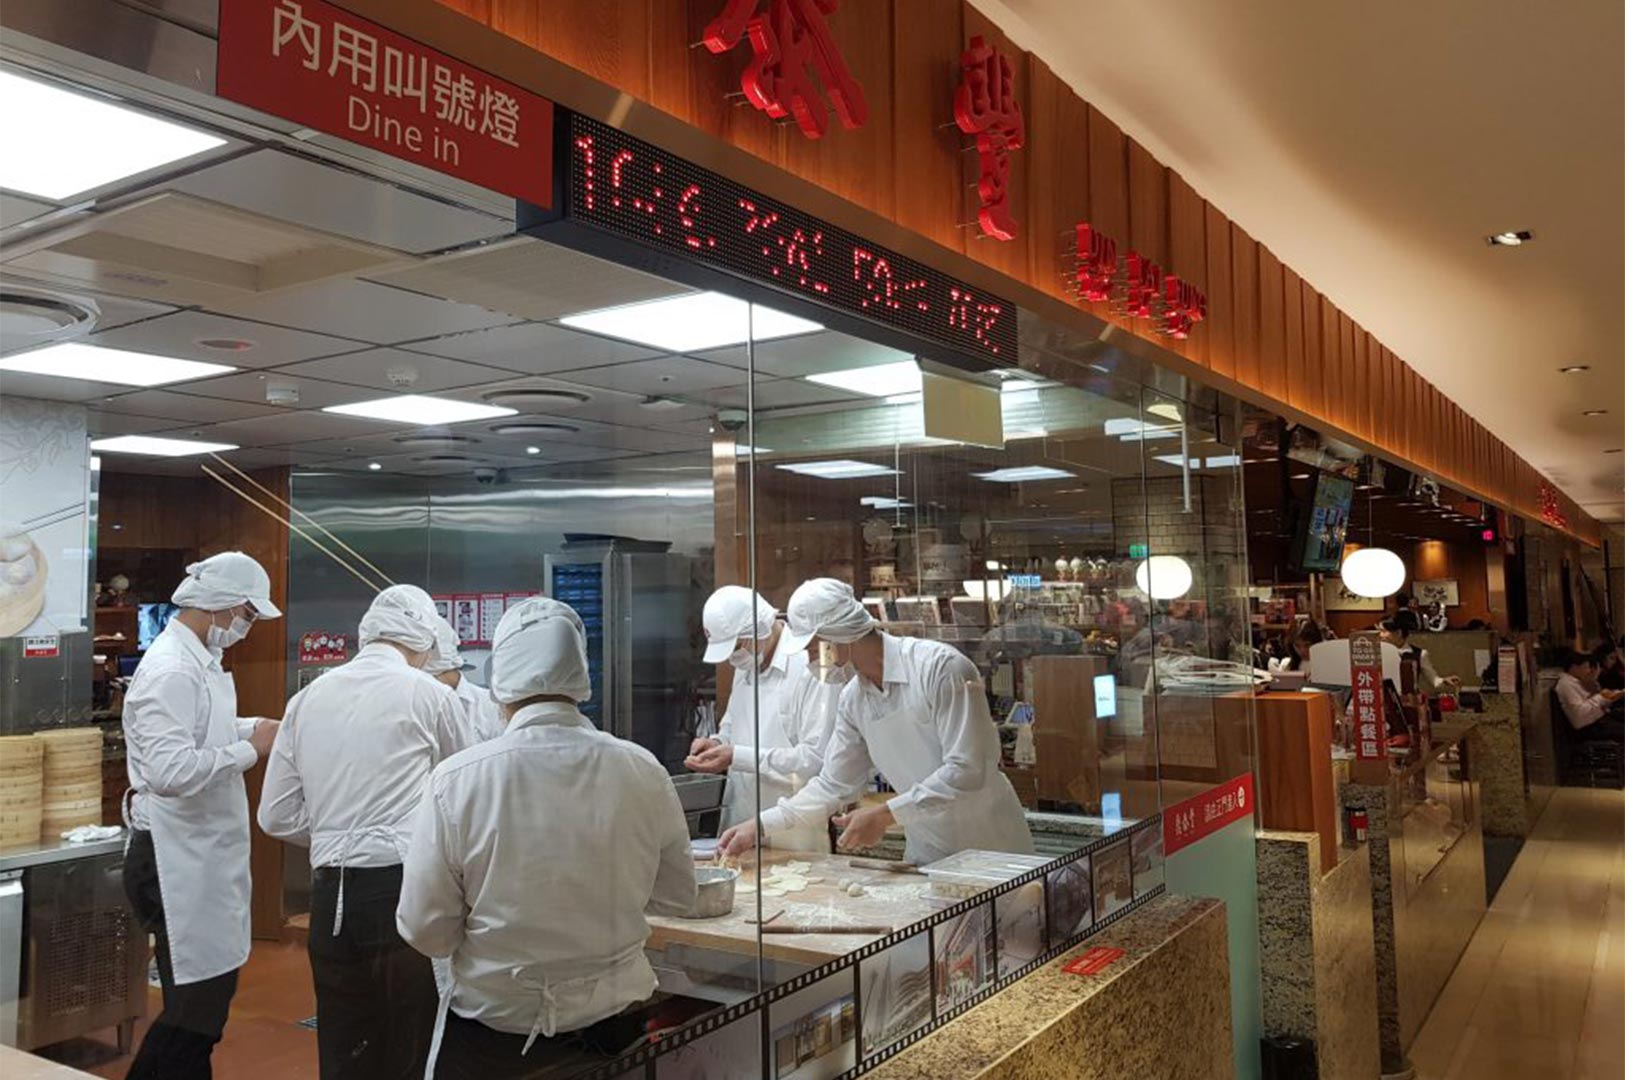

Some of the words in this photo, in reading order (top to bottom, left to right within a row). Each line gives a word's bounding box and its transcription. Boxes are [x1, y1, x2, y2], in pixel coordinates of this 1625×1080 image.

[272, 0, 520, 148] 內用叫號燈
[349, 96, 423, 152] Dine
[434, 128, 459, 166] in
[1358, 671, 1378, 757] 外帶點餐區
